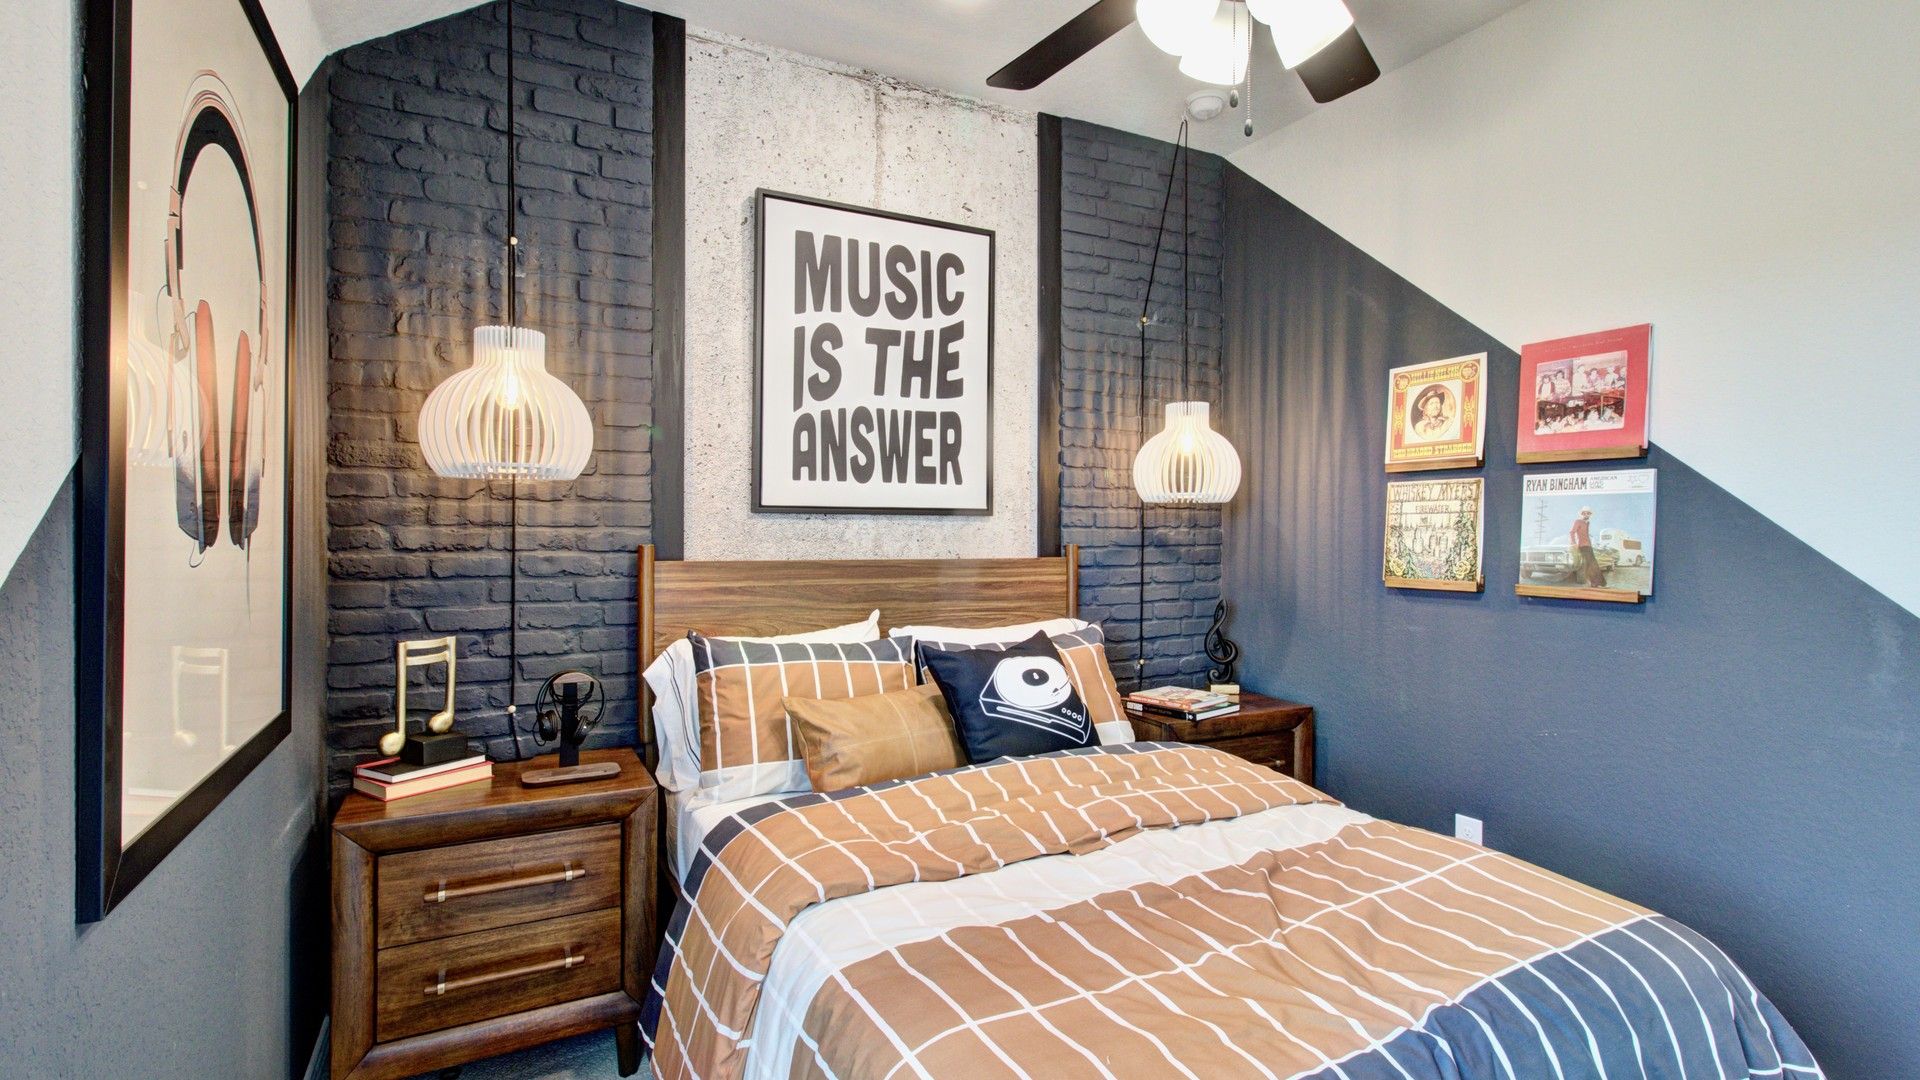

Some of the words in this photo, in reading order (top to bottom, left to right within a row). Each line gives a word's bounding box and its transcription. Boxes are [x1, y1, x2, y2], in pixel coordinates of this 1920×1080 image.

[794, 230, 965, 320] MUSIC
[793, 322, 843, 412] IS
[865, 320, 964, 399] THE
[792, 406, 963, 485] ANSWER
[1526, 479, 1548, 491] RYAN
[1549, 477, 1587, 490] BINGHAM
[1393, 484, 1433, 501] WHISKEY
